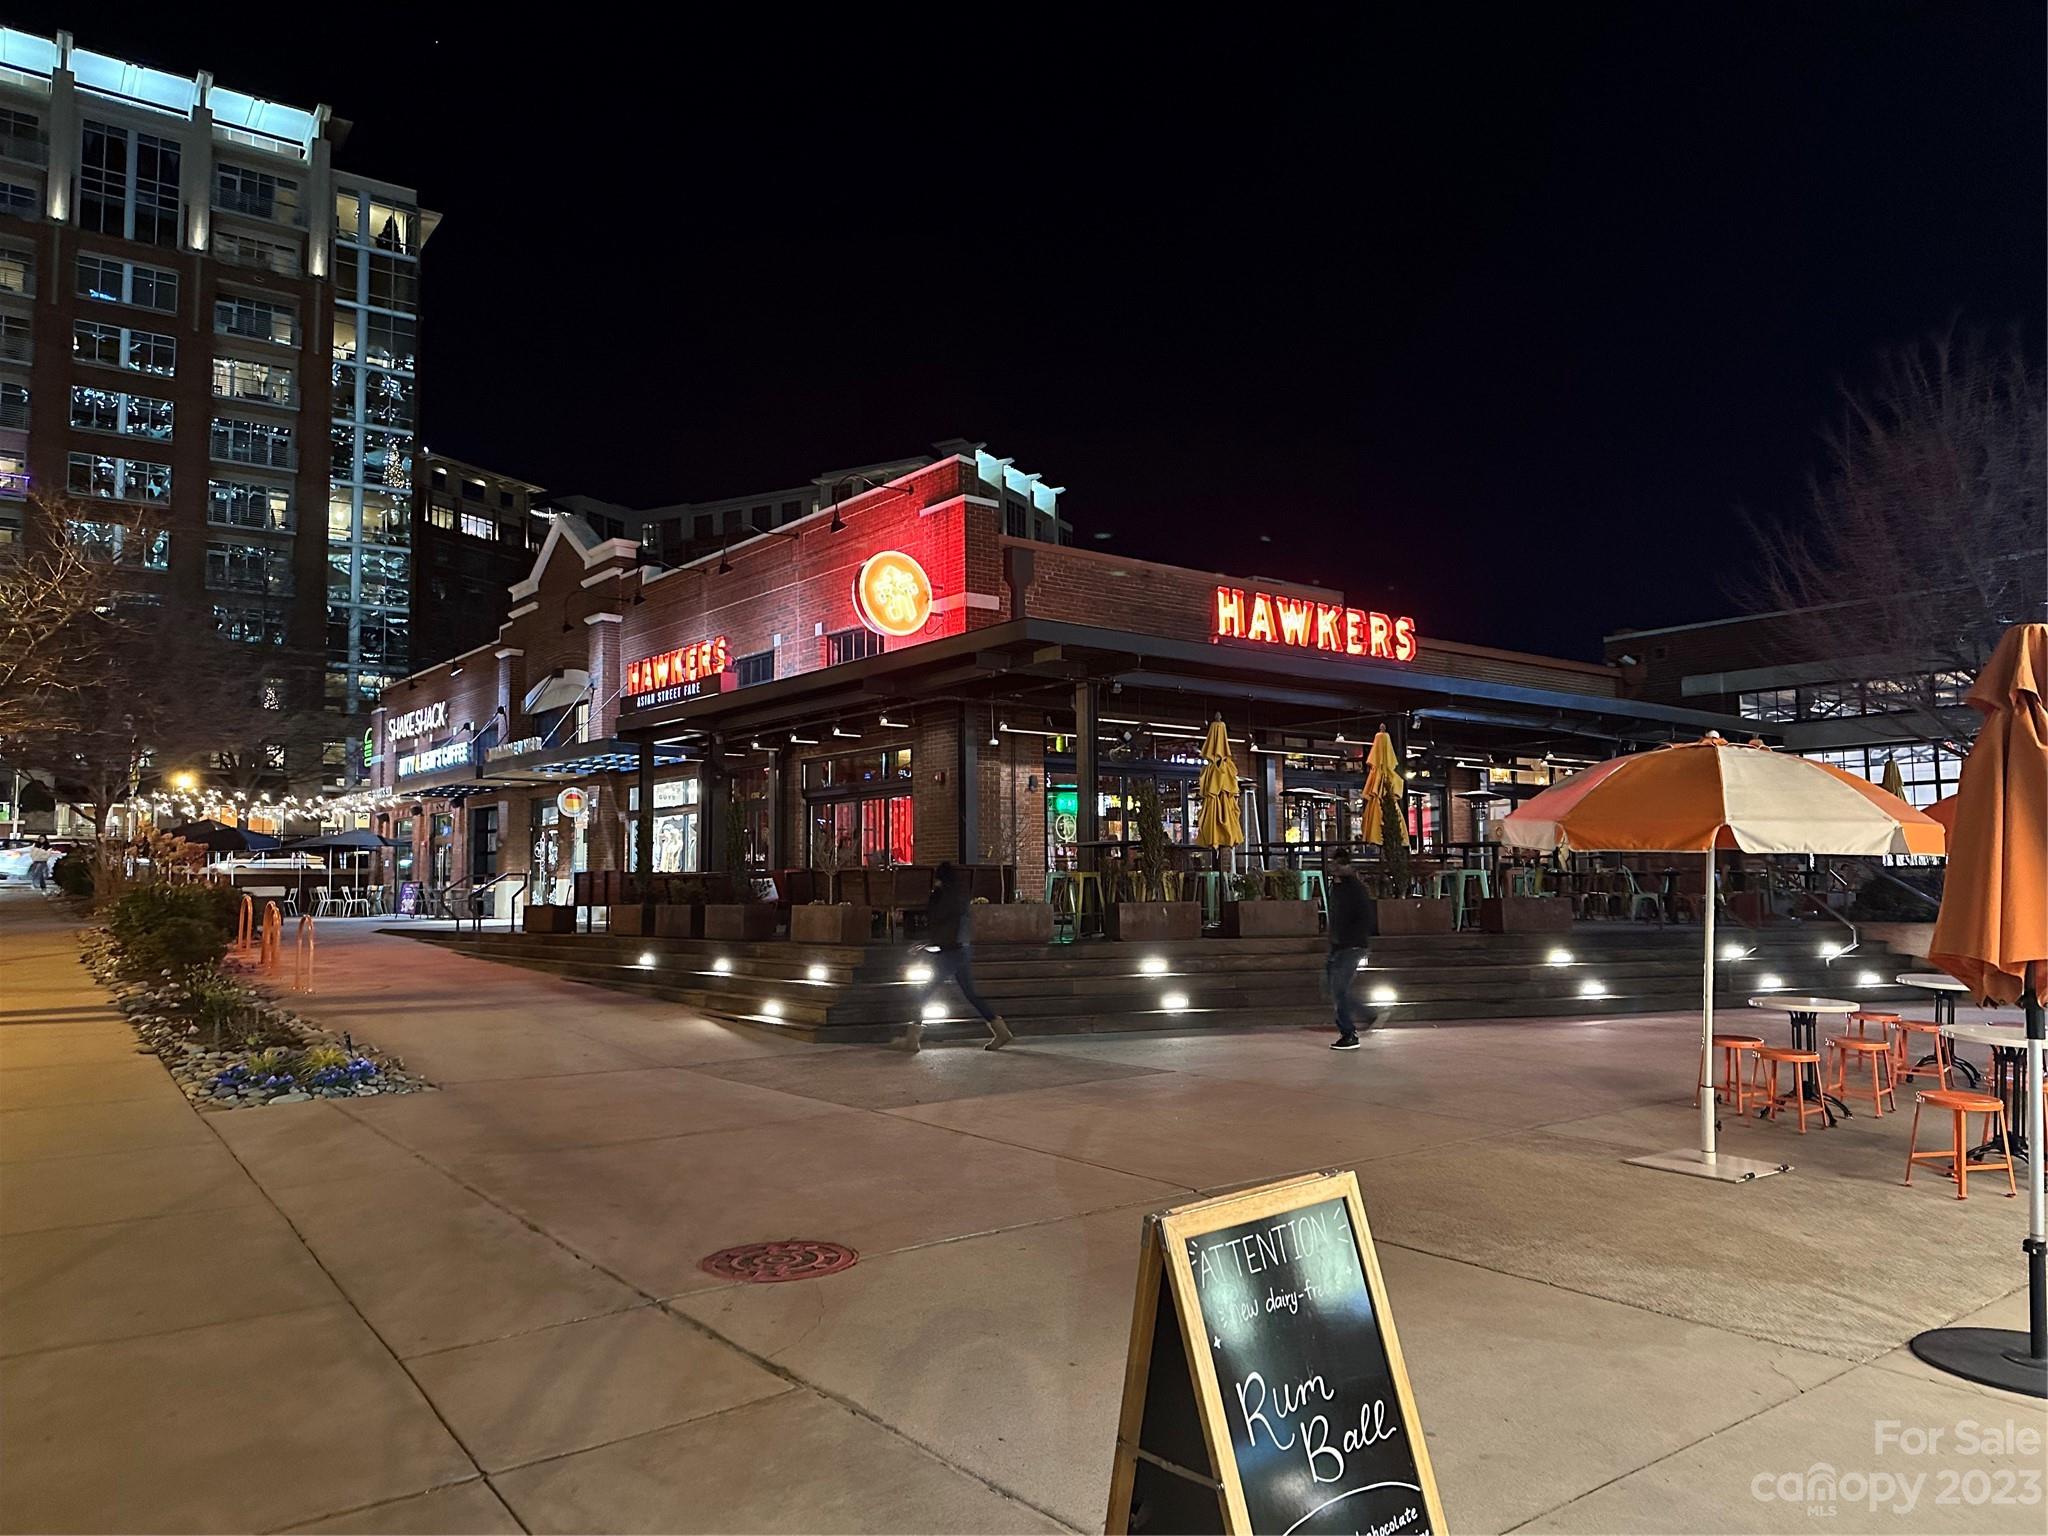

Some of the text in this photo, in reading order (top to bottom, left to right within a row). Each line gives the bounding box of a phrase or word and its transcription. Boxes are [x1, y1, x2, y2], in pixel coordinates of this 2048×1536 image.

[1217, 585, 1416, 662] HAWKERS
[626, 636, 727, 696] HAWKERS
[637, 682, 701, 708] ASIAN STREET FARE
[388, 700, 446, 742] SHAKE SHACK
[1201, 1212, 1329, 1289] ATTENTION
[1235, 1371, 1335, 1451] Rum
[1300, 1400, 1397, 1483] Ball
